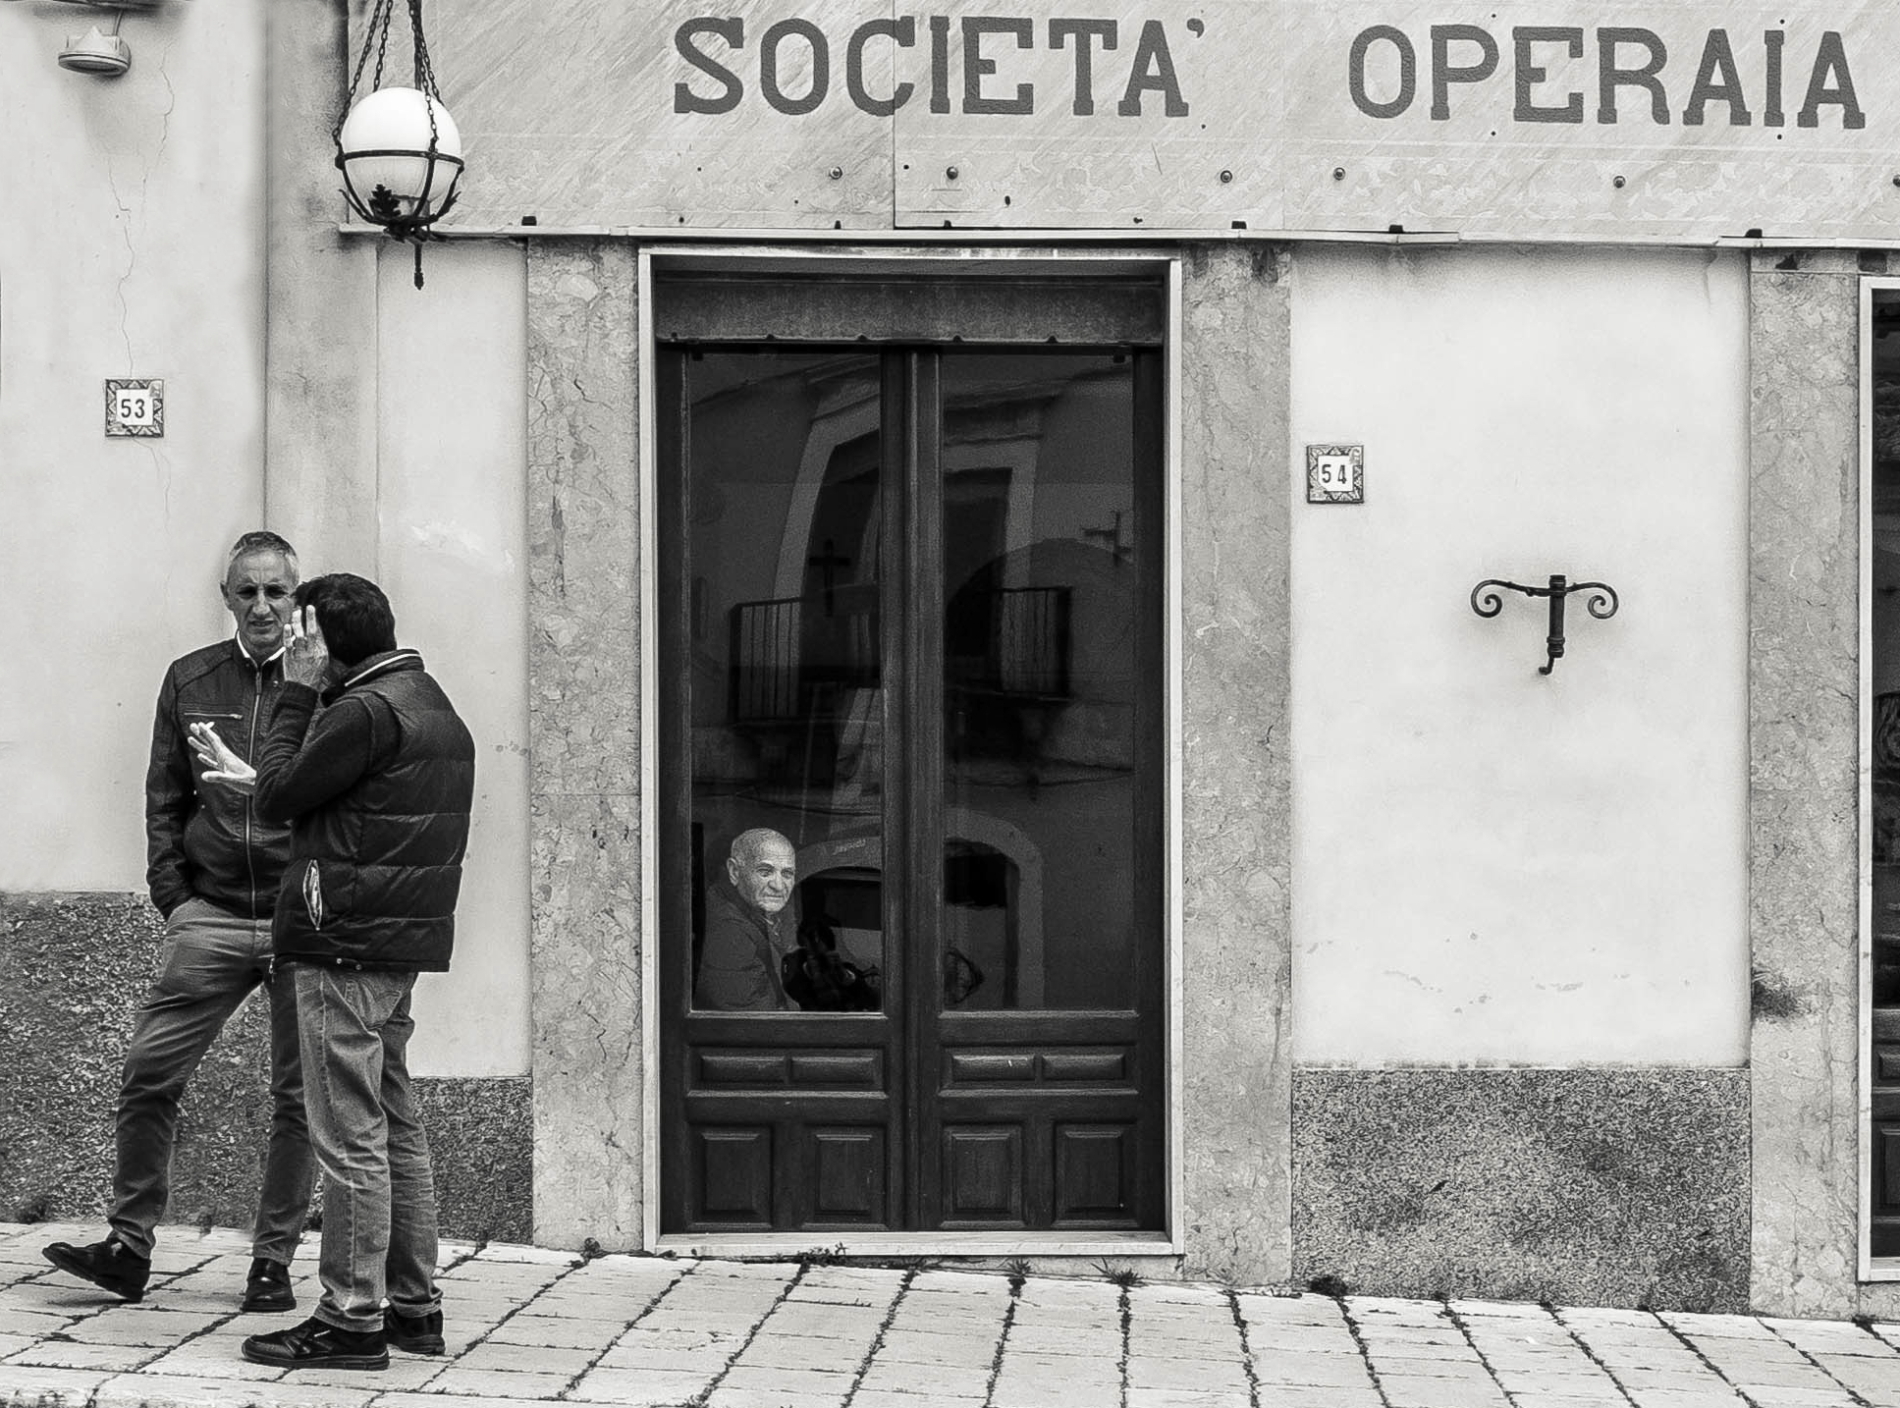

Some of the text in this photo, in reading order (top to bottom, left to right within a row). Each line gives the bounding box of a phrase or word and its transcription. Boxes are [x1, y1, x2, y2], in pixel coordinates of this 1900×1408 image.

[674, 15, 1866, 129] SOCIETA' OPERAIA
[121, 398, 145, 419] 53
[1321, 463, 1347, 484] 54
